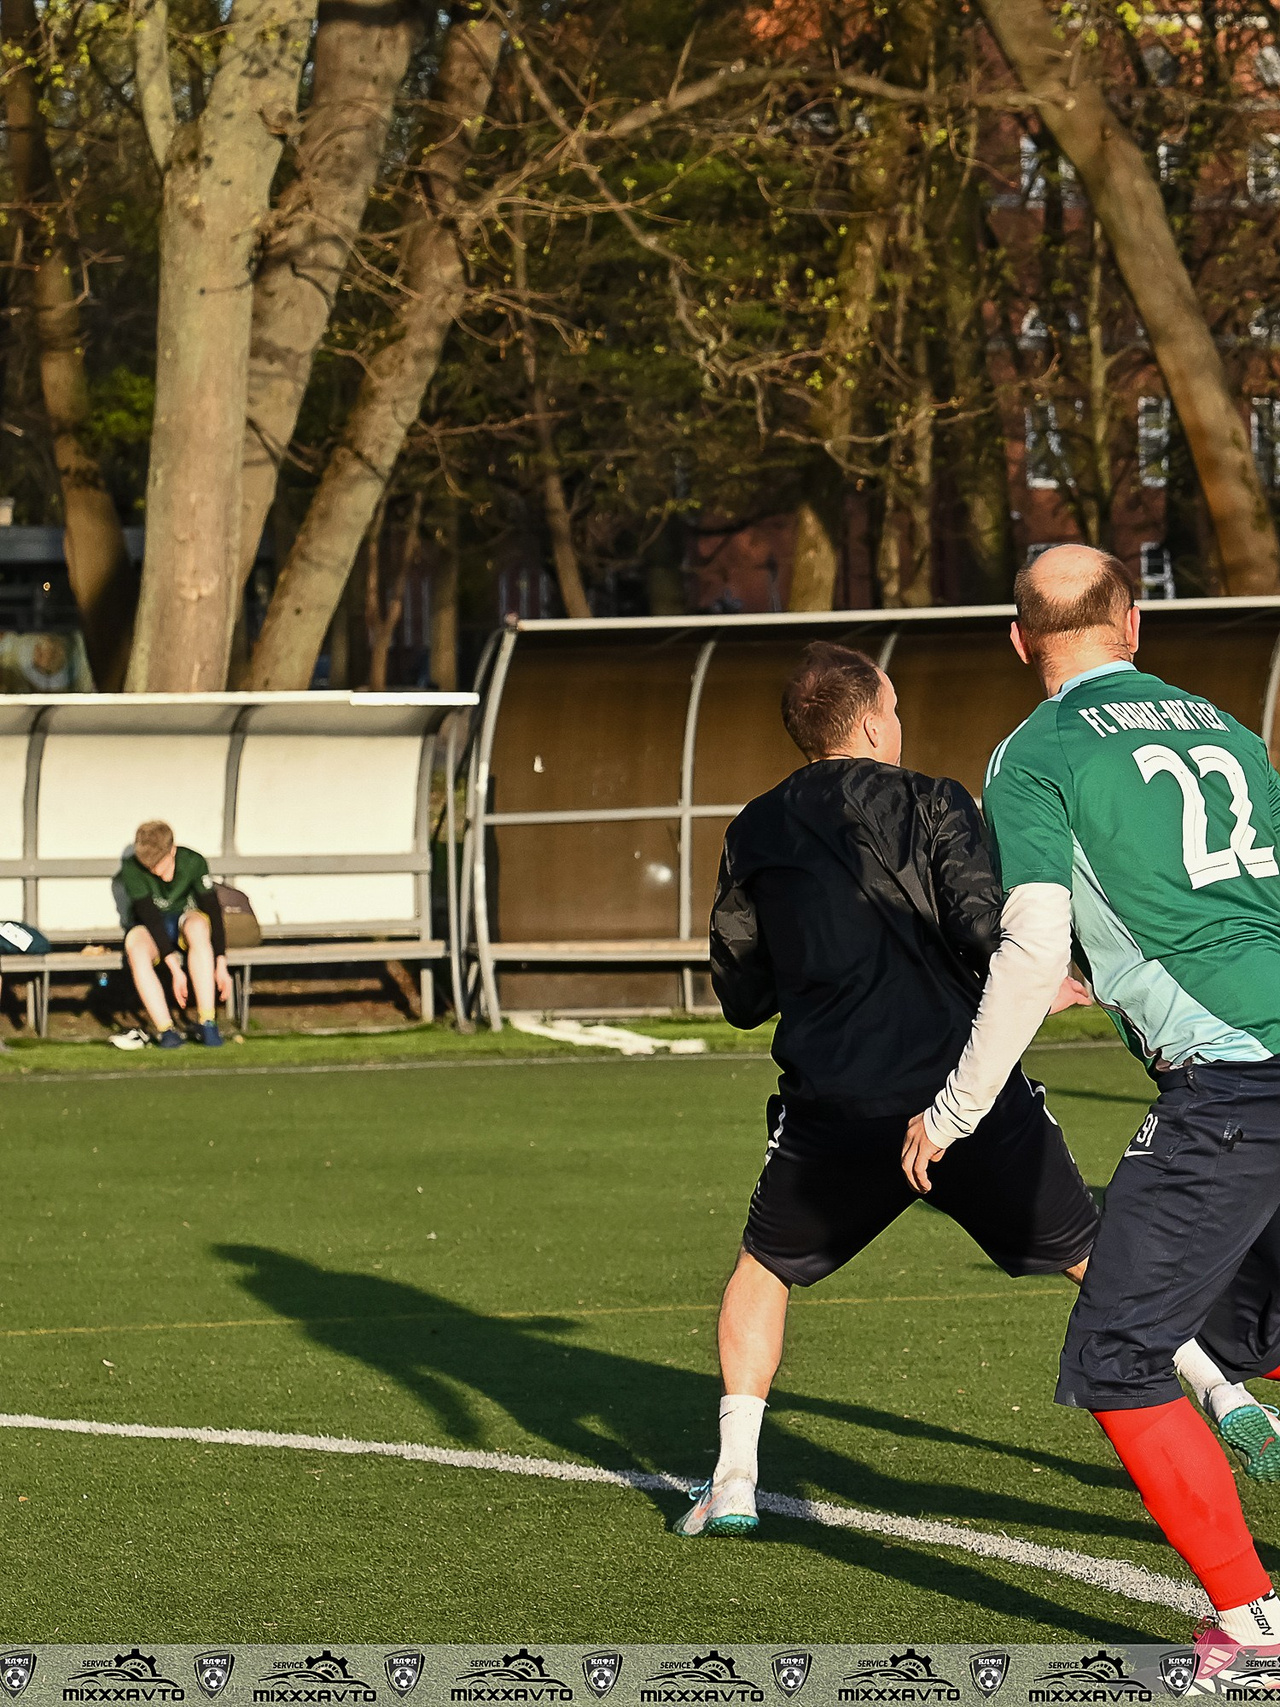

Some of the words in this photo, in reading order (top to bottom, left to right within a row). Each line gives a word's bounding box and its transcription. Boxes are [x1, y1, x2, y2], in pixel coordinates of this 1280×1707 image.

[1078, 707, 1119, 738] FC
[1101, 699, 1201, 731] ARARAT-ART
[1131, 743, 1280, 890] 22
